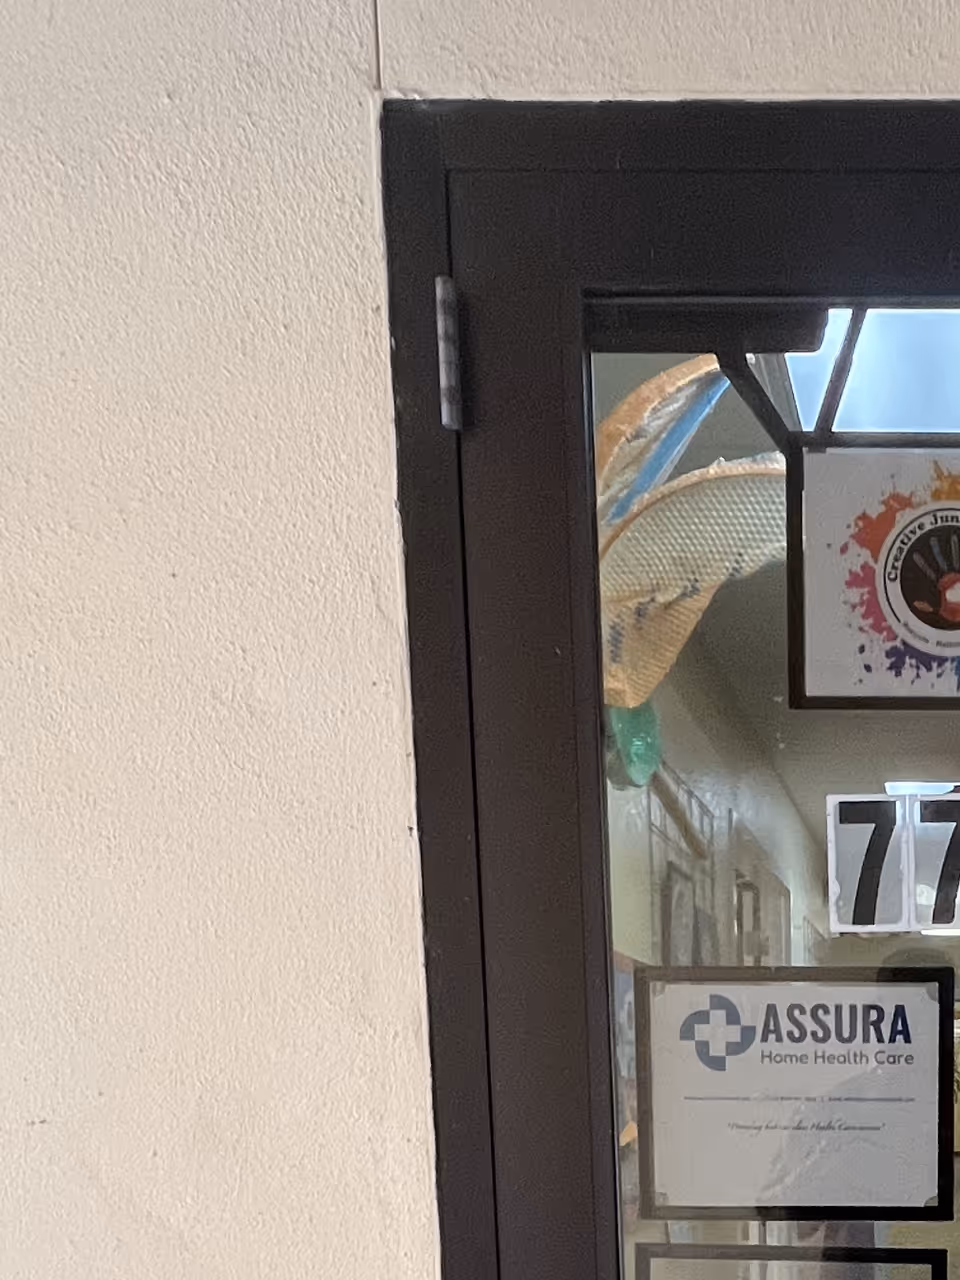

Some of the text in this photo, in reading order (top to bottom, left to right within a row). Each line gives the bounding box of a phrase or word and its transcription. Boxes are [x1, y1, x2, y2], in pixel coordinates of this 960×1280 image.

[887, 522, 926, 583] Creative
[760, 1003, 912, 1045] ASSURA
[760, 1051, 915, 1066] Home Health Care
